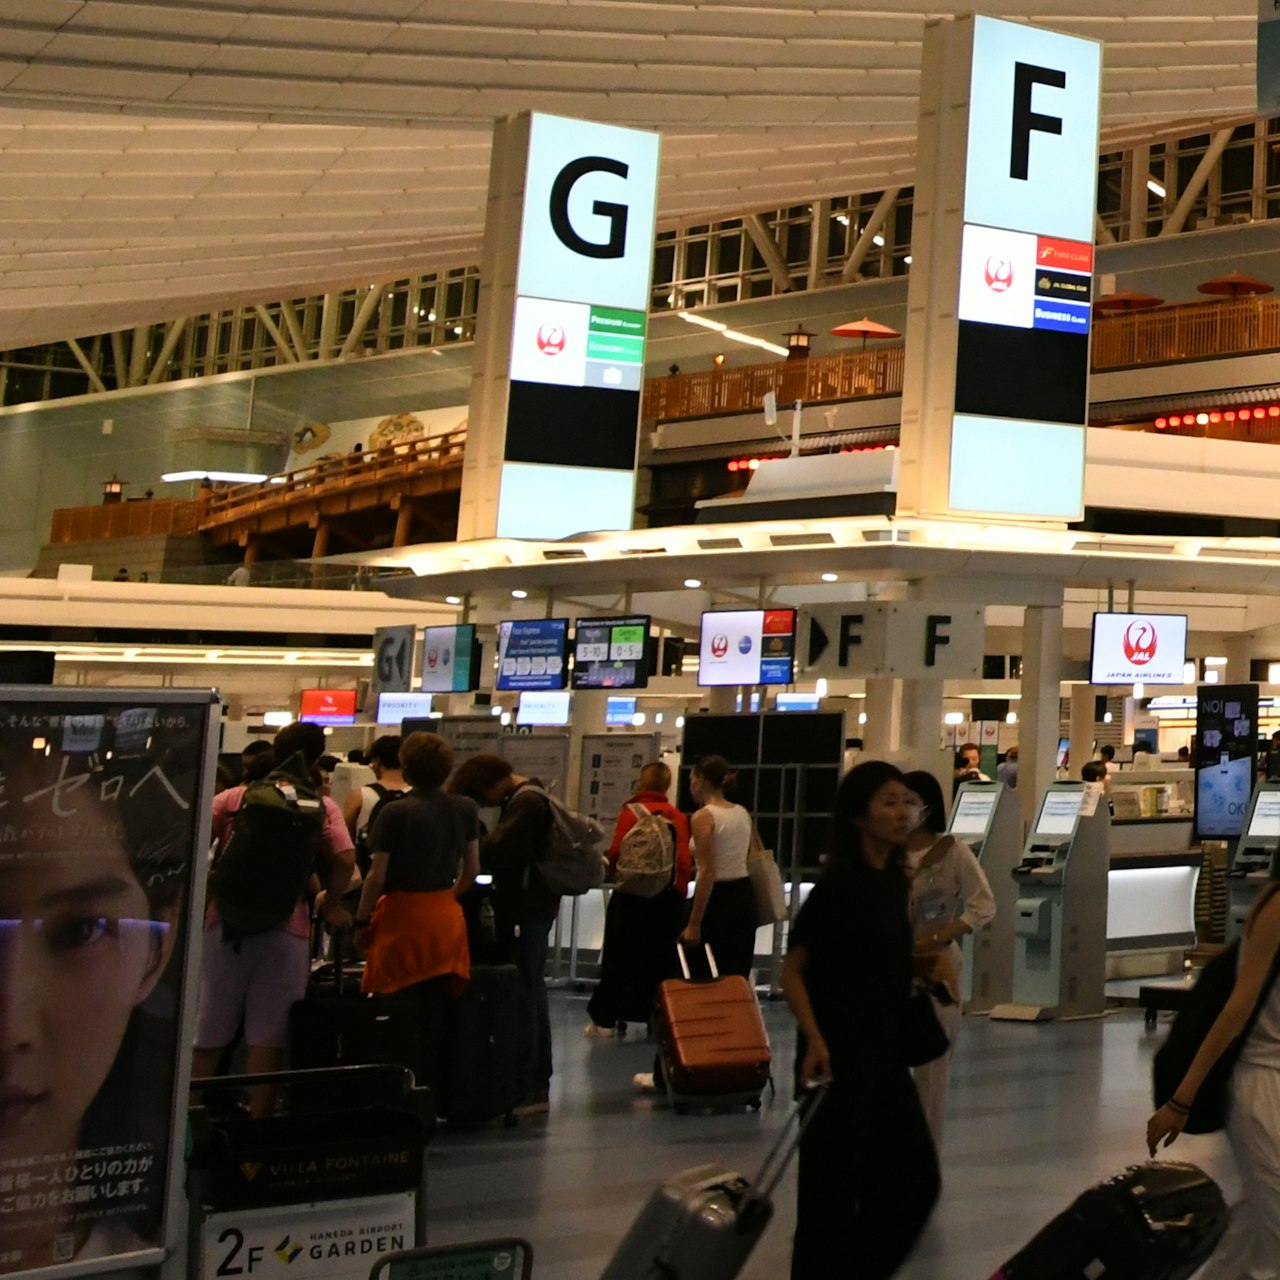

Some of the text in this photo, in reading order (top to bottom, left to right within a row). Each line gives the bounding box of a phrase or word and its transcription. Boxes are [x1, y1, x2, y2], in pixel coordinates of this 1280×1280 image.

[1009, 61, 1066, 181] F
[548, 155, 630, 260] G
[838, 614, 865, 668] F
[924, 615, 952, 667] F
[1106, 671, 1132, 679] JAPAN
[270, 1151, 410, 1176] VILLA FONTAINE
[216, 1223, 404, 1277] 2F HANEDA AIRPORT
[310, 1235, 404, 1260] GARDEN
